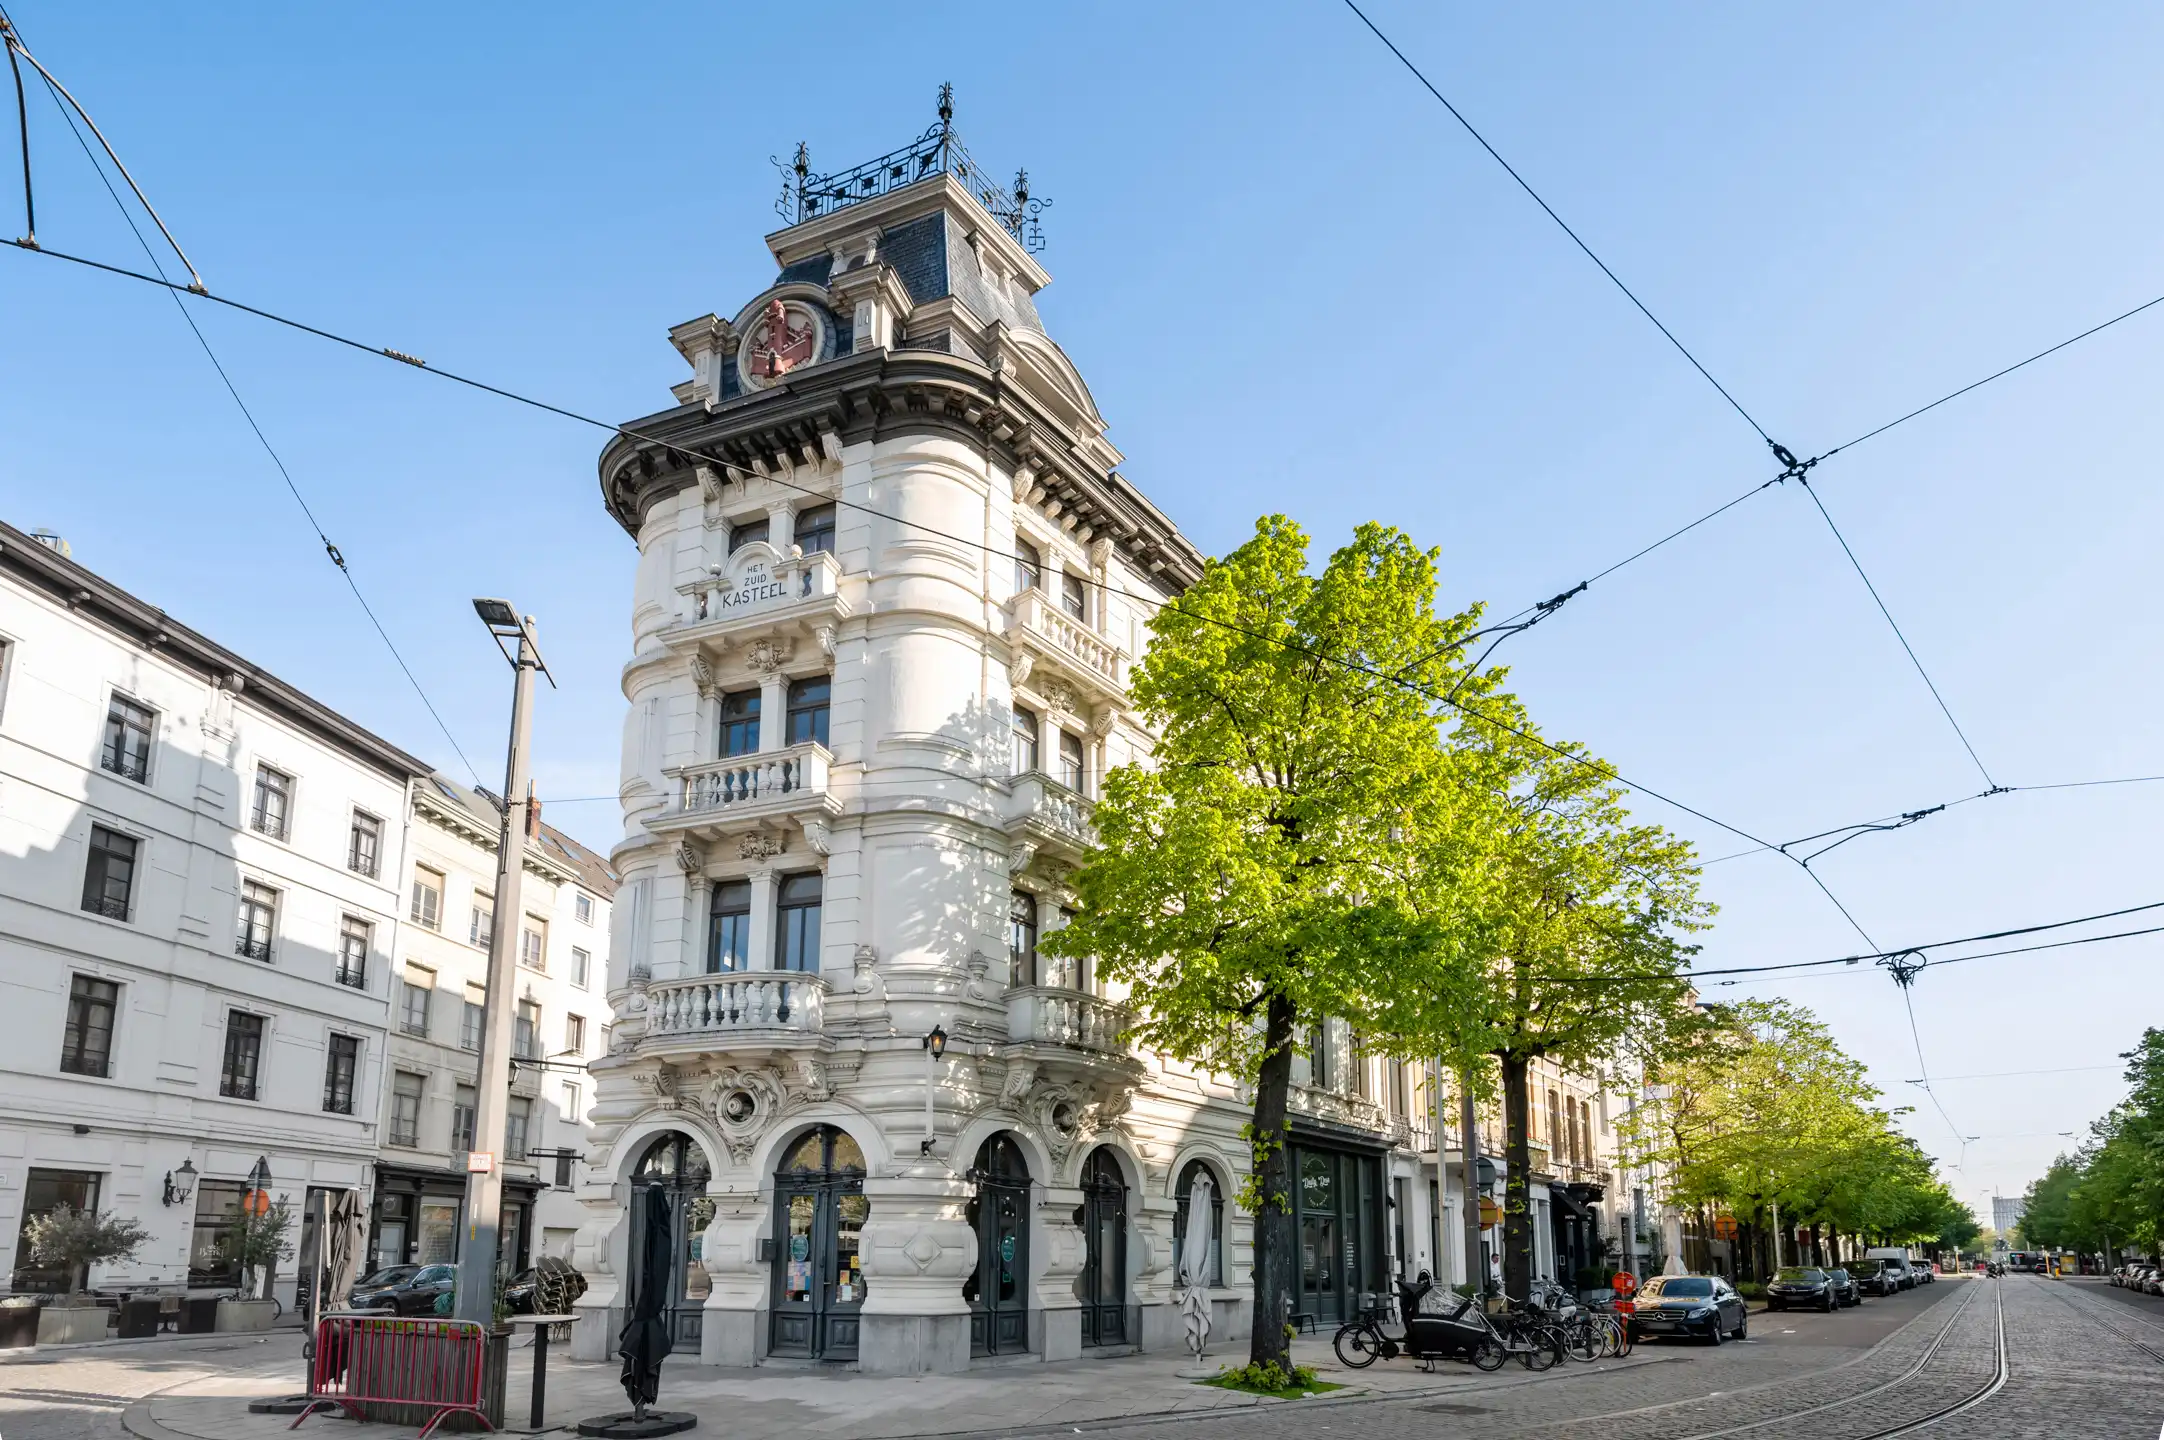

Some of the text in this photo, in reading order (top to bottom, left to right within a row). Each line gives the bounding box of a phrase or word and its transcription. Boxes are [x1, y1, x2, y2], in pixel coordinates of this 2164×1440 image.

[747, 563, 764, 573] HET
[744, 573, 767, 586] ZUID
[722, 582, 787, 608] KASTEEL
[729, 1184, 734, 1193] 2
